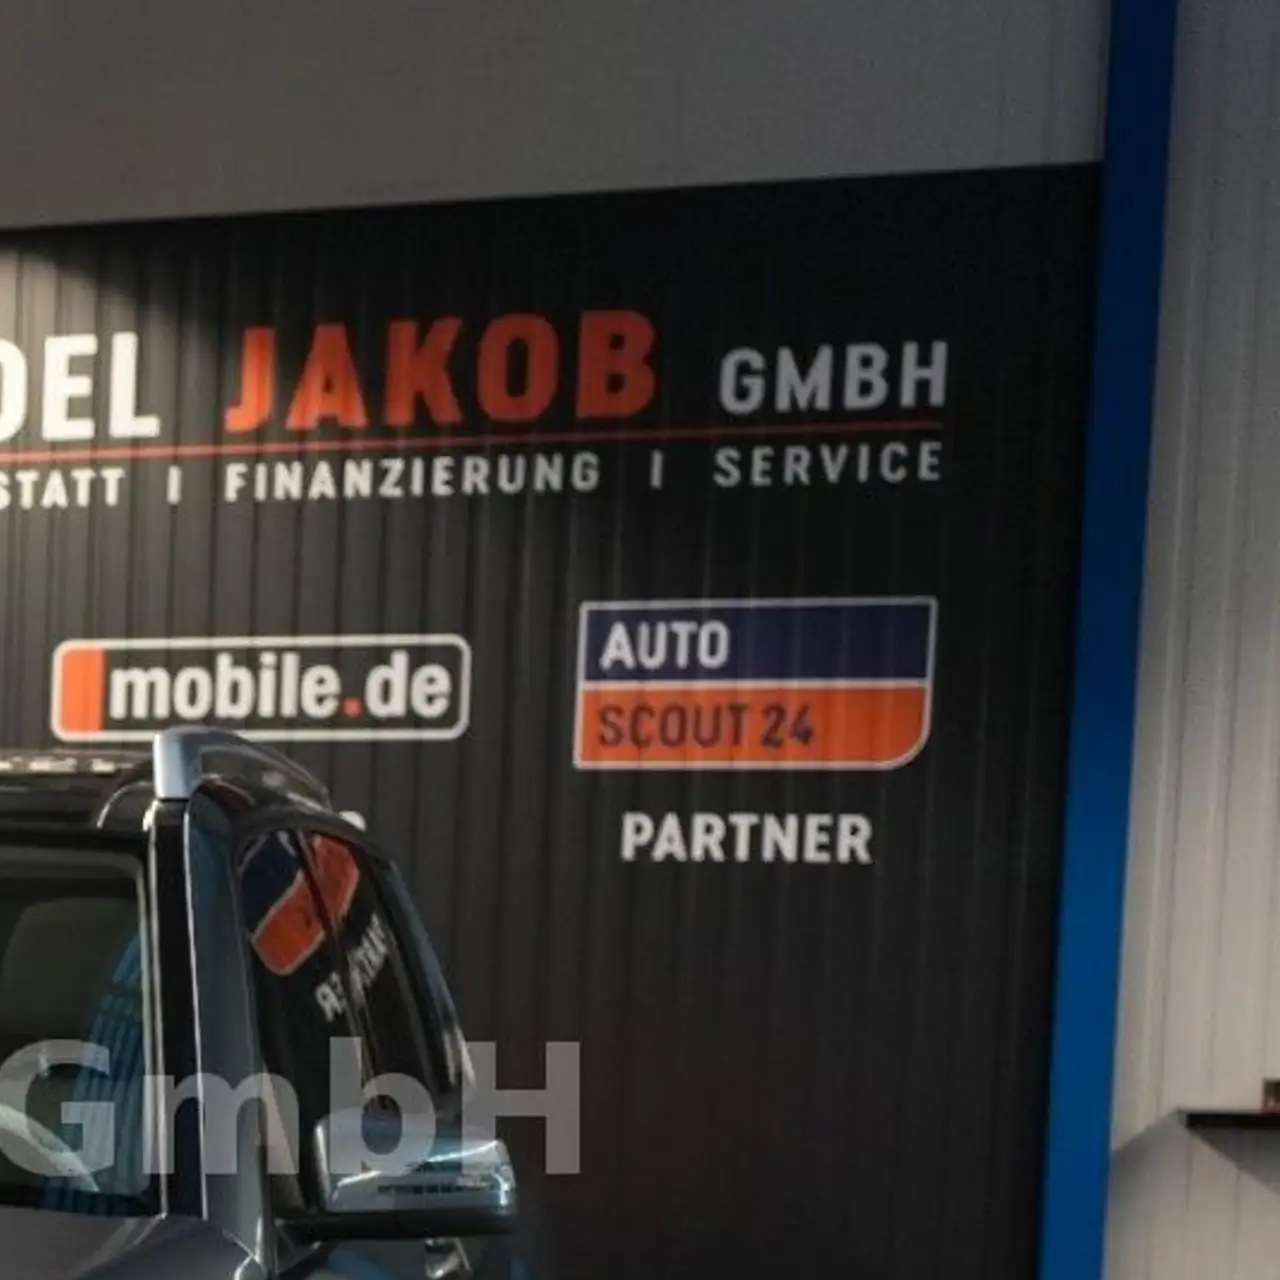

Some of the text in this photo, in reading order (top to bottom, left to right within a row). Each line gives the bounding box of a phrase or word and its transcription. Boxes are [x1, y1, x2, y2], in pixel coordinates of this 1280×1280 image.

[225, 309, 657, 433] JAKOB
[719, 340, 948, 414] GMBH
[224, 452, 600, 504] FINANZIERUNG
[713, 441, 943, 488] SERVICE
[599, 620, 731, 671] AUTO
[108, 650, 452, 719] mobile.de
[621, 812, 873, 865] PARTNER
